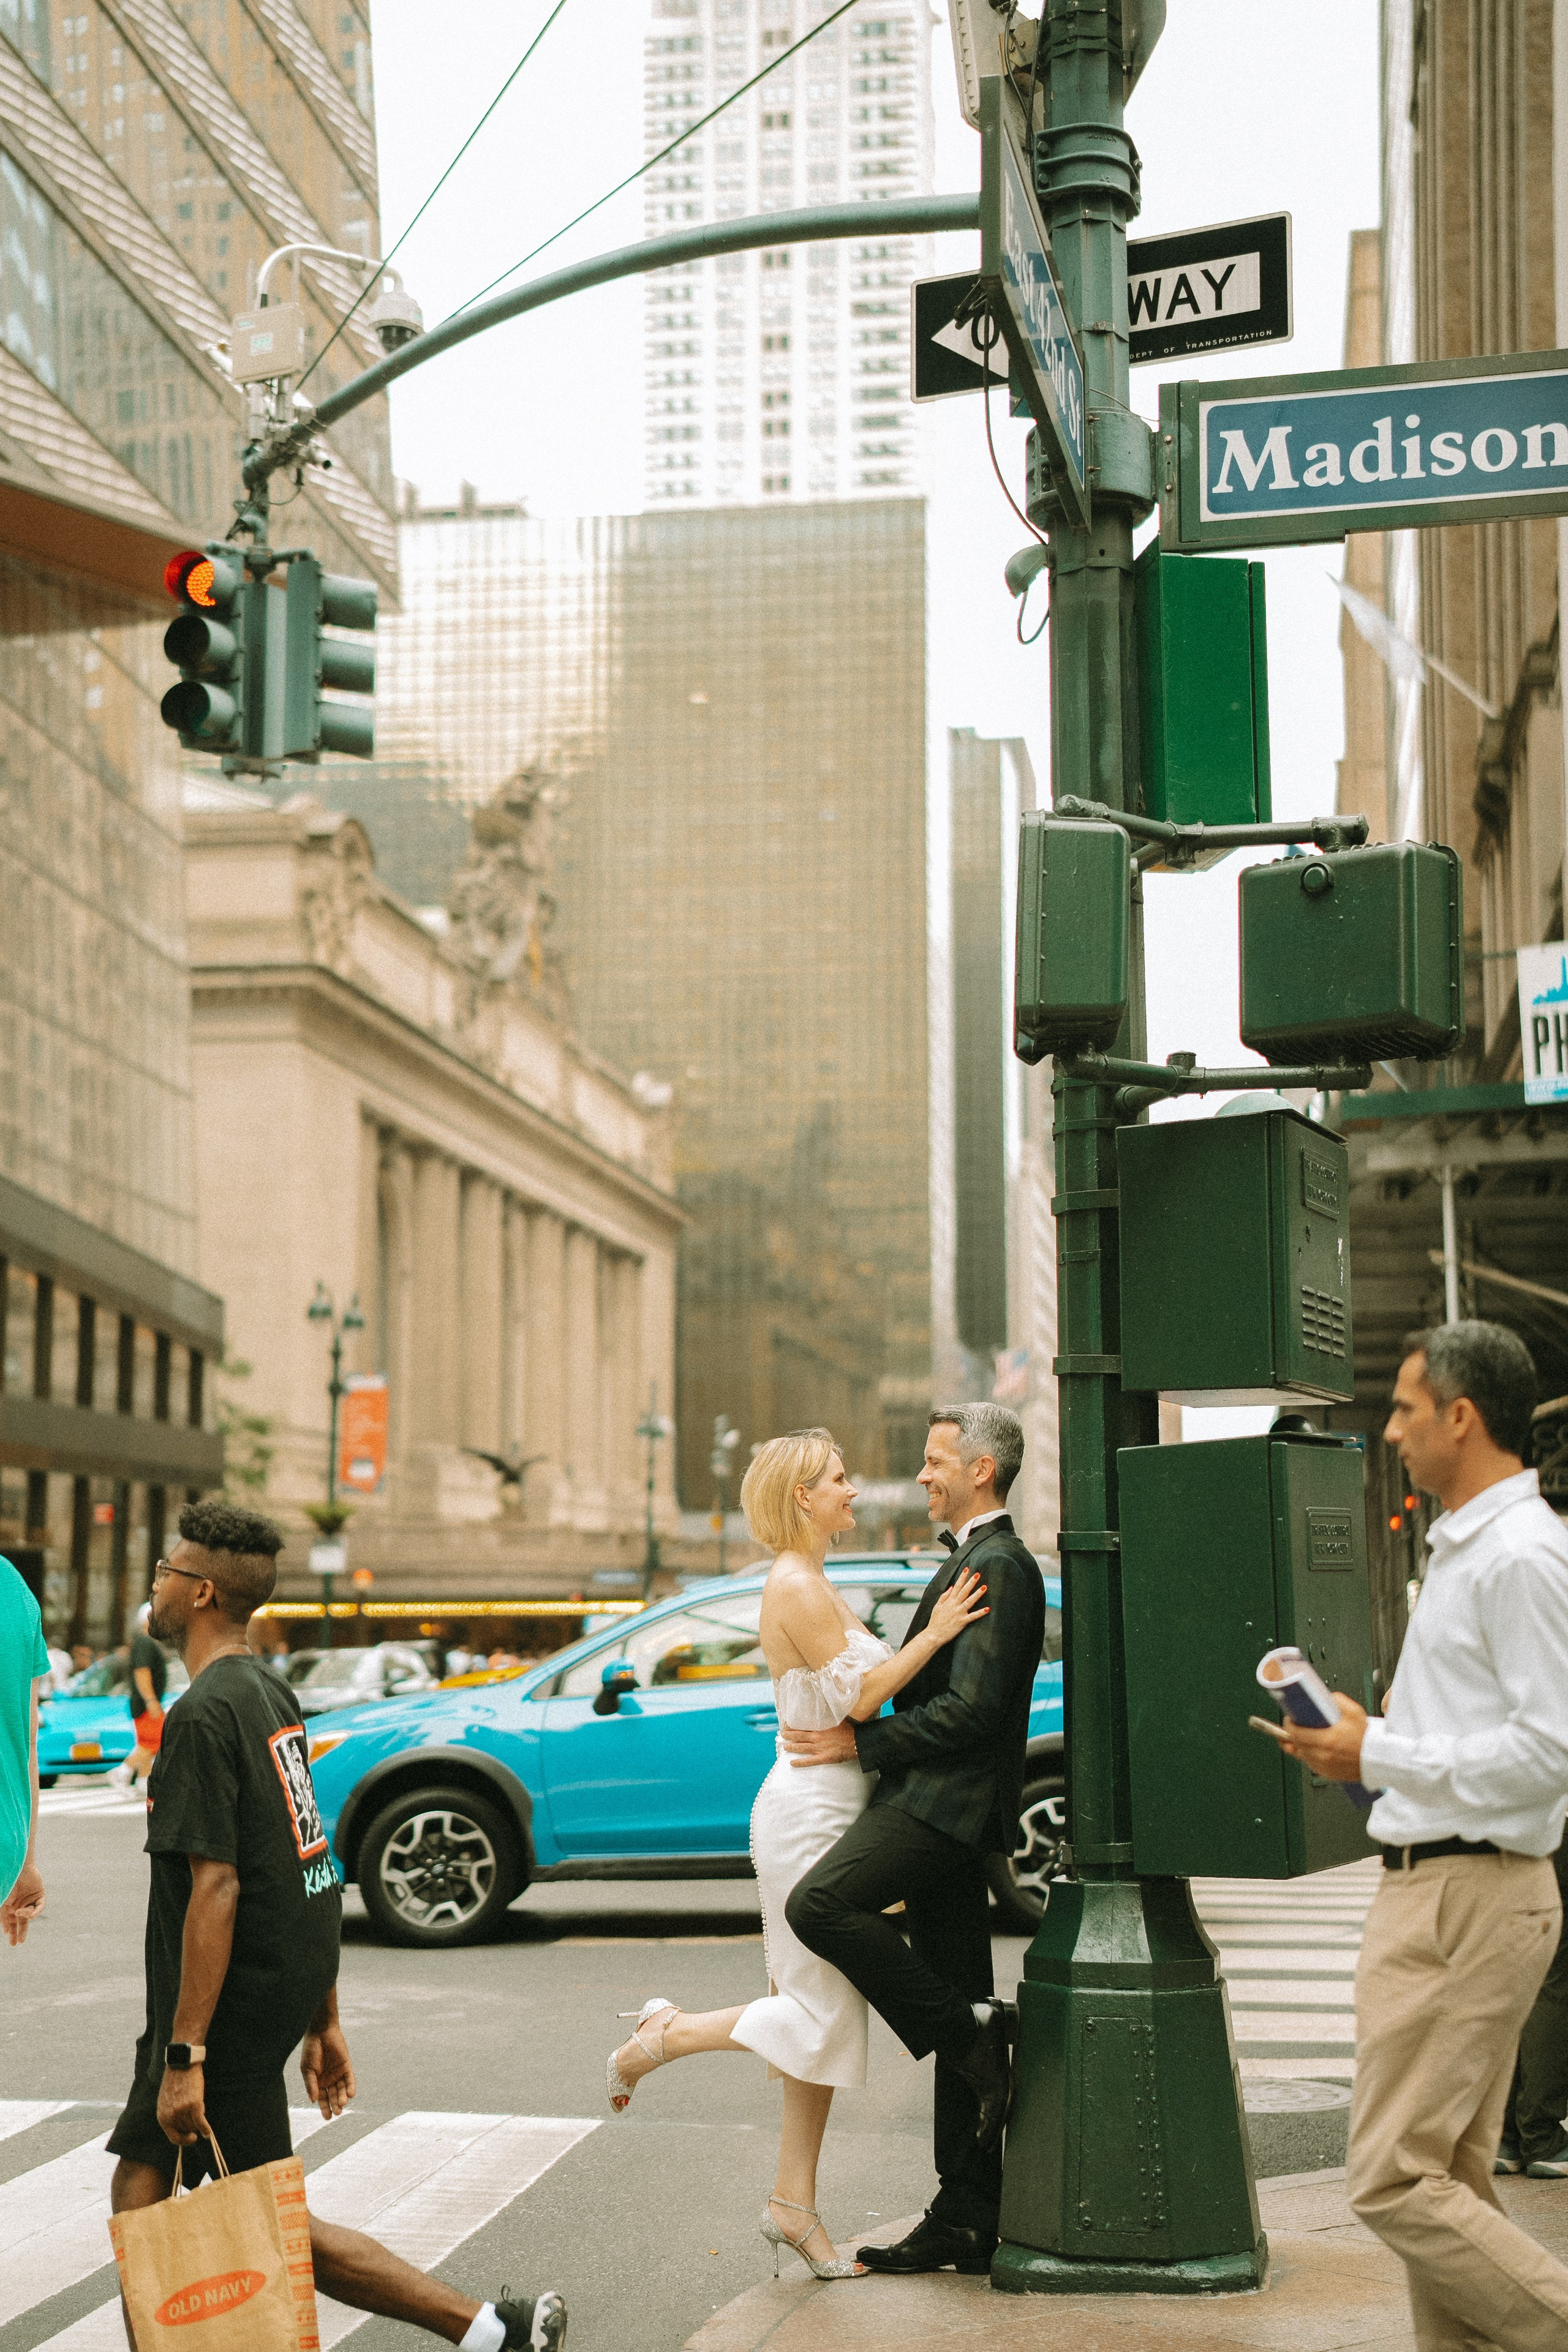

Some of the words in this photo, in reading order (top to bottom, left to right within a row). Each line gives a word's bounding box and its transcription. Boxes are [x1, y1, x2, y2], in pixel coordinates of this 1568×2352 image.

[1128, 264, 1237, 326] WAY
[1129, 351, 1153, 360] DEPT
[1186, 330, 1273, 350] TRANSPORTATION
[1069, 369, 1082, 457] St
[1212, 415, 1568, 494] Madison
[168, 2294, 202, 2320] OLD
[205, 2274, 252, 2307] NAVY
